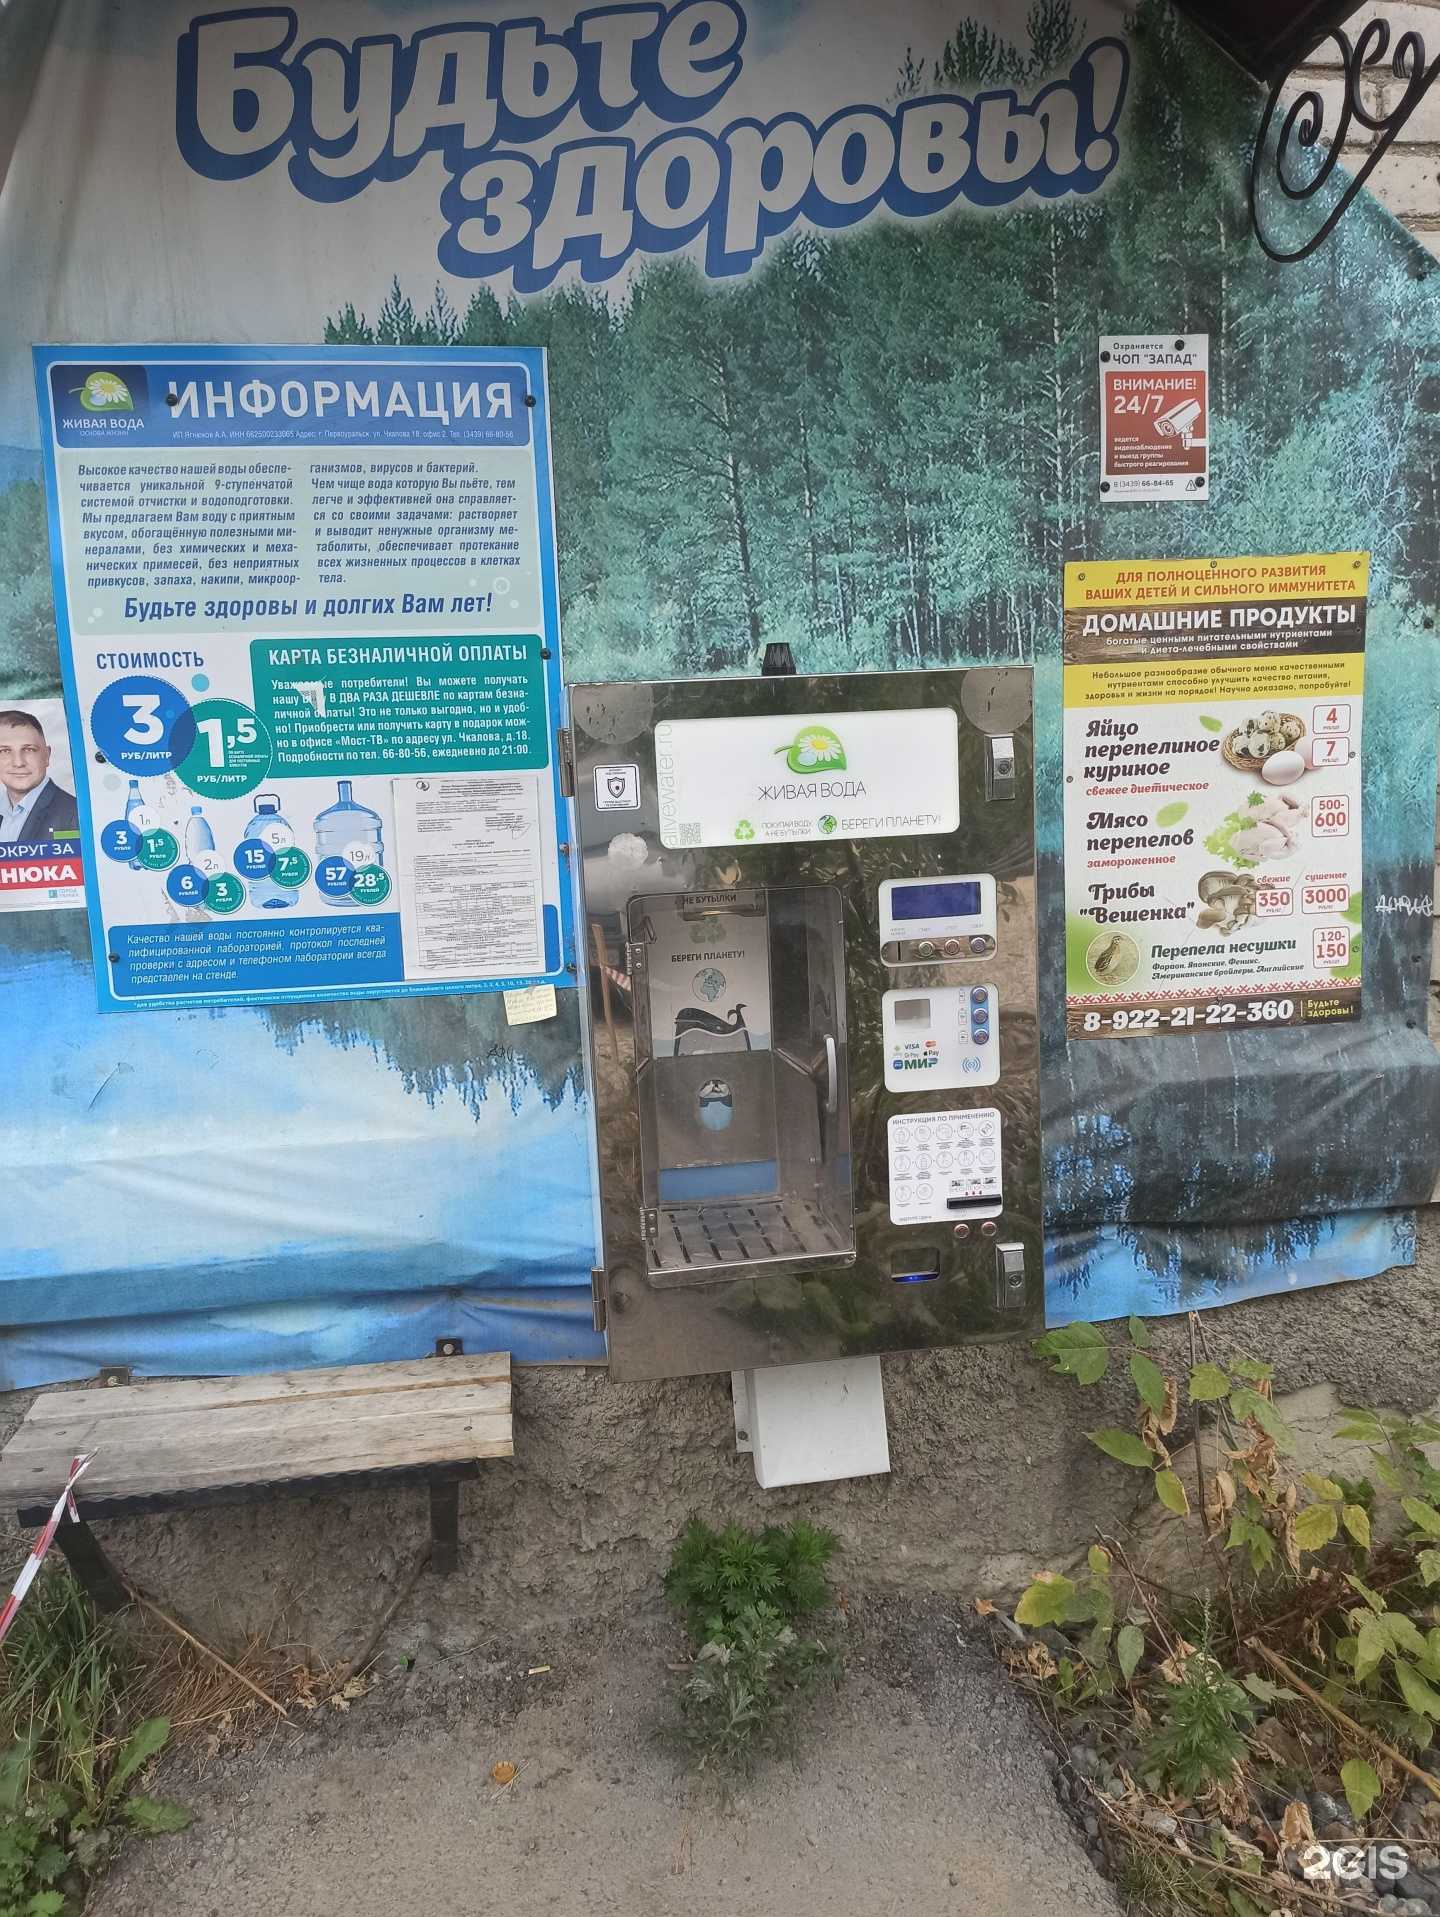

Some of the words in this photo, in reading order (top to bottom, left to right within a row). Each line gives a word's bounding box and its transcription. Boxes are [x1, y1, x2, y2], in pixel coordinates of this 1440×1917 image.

[197, 2, 741, 180] Будьте
[456, 45, 1119, 270] здоровы!
[1113, 354, 1139, 364] ЧОП
[1144, 354, 1197, 365] "ЗАПАД"
[1114, 379, 1196, 390] ВНИМАНИЕ!
[168, 379, 512, 425] ИНФОРМАЦИЯ
[1114, 393, 1164, 414] 24/7
[63, 419, 106, 429] ЖИВАЯ
[111, 419, 144, 429] ВОДА
[78, 465, 127, 475] Высокое
[129, 465, 178, 474] качество
[180, 464, 216, 474] нашей
[218, 465, 246, 475] воды
[371, 465, 413, 474] вирусов
[427, 462, 478, 474] бактерий.
[80, 482, 130, 492] чивается
[141, 480, 205, 492] уникальной
[215, 479, 293, 491] 9-ступенчатой
[338, 480, 365, 490] чище
[368, 480, 393, 489] вода
[396, 480, 439, 490] которую
[81, 497, 135, 508] системой
[139, 497, 187, 507] отчистки
[312, 496, 343, 505] легче
[357, 494, 432, 506] эффективней
[105, 513, 173, 524] предлагаем
[202, 513, 227, 523] воду
[240, 512, 295, 523] приятным
[350, 512, 390, 520] своими
[397, 511, 452, 521] задачами:
[459, 510, 517, 521] растворяет
[210, 528, 274, 538] полезными
[327, 527, 372, 537] выводит
[378, 527, 432, 536] ненужные
[438, 526, 494, 536] организму
[180, 544, 245, 554] химических
[379, 542, 453, 551] обеспечивает
[460, 542, 519, 551] протекание
[87, 562, 137, 570] нических
[234, 560, 299, 570] неприятных
[318, 558, 341, 567] всех
[346, 558, 407, 567] жизненных
[411, 557, 466, 568] процессов
[481, 557, 520, 566] клетках
[319, 574, 346, 583] тела.
[1117, 572, 1142, 584] ДЛЯ
[1147, 568, 1257, 582] ПОЛНОЦЕННОГО
[1262, 565, 1326, 577] РАЗВИТИЯ
[1086, 588, 1131, 600] ВАШИХ
[1136, 585, 1177, 599] ДЕТЕЙ
[1182, 585, 1190, 596] И
[1194, 584, 1264, 596] СИЛЬНОГО
[1269, 580, 1355, 592] ИММУНИТЕТА
[124, 598, 196, 622] Будьте
[204, 600, 297, 620] здоровы
[305, 599, 316, 614] и
[323, 597, 395, 617] долгих
[402, 594, 444, 614] Вам
[450, 592, 492, 612] лет!
[1083, 610, 1221, 636] ДОМАШНИЕ
[1230, 604, 1355, 630] ПРОДУКТЫ
[1106, 637, 1146, 646] богатые
[1151, 635, 1194, 645] ценными
[1197, 632, 1267, 643] питательными
[1270, 629, 1333, 640] нутриентами
[269, 649, 321, 665] КАРТА
[327, 643, 453, 664] БЕЗНАЛИЧНОЙ
[459, 645, 527, 661] ОПЛАТЫ
[1150, 642, 1237, 655] диета-лечебными
[1240, 641, 1298, 650] свойствами
[97, 652, 204, 669] СТОИМОСТЬ
[341, 678, 408, 689] потребители!
[439, 677, 476, 686] можете
[485, 676, 528, 685] получать
[273, 695, 299, 706] нашу
[363, 692, 389, 702] РАЗА
[392, 690, 439, 702] ДЕШЕВЛЕ
[458, 690, 493, 700] картам
[395, 707, 428, 716] только
[1325, 709, 1338, 724] 4
[122, 695, 164, 745] 3
[295, 722, 354, 734] Приобрести
[378, 721, 423, 731] получить
[425, 720, 452, 731] карту
[463, 719, 503, 729] подарок
[1087, 720, 1138, 742] Яйцо
[197, 718, 257, 768] 1,5
[300, 737, 332, 750] офисе
[406, 734, 439, 745] адресу
[1085, 738, 1220, 759] перепелиное
[1326, 741, 1336, 756] 7
[121, 752, 172, 760] РУБ/ЛИТР
[278, 751, 344, 764] Подробности
[433, 747, 486, 758] ежедневно
[1084, 762, 1170, 782] куриное
[197, 775, 247, 783] РУБ/ЛИТР
[659, 723, 677, 848] alivewater.ru
[758, 783, 817, 800] ЖИВАЯ
[820, 781, 866, 798] ВОДА
[1086, 786, 1128, 796] свежее
[1130, 781, 1209, 794] диетическое
[1319, 800, 1344, 810] 500-
[842, 817, 884, 831] БЕРЕГИ
[885, 814, 942, 828] ПЛАНЕТУ!
[1086, 811, 1148, 830] Мясо
[1315, 813, 1345, 827] 600
[116, 831, 128, 844] 3
[1087, 829, 1193, 852] перепелов
[52, 843, 74, 855] ЗА
[244, 850, 264, 862] 15
[1088, 855, 1176, 868] замороженное
[326, 868, 346, 880] 57
[1257, 875, 1290, 884] свежие
[1305, 872, 1347, 881] сушеные
[181, 876, 193, 889] 6
[216, 883, 228, 896] 3
[1088, 883, 1155, 904] Грибы
[1305, 889, 1346, 903] 3000
[695, 895, 736, 904] БУТЫЛКИ
[1258, 891, 1290, 906] 350
[1079, 902, 1194, 923] "Вешенка"
[1320, 931, 1344, 941] 120-
[1152, 945, 1225, 961] Перепела
[1229, 938, 1296, 955] несушки
[1317, 944, 1346, 958] 150
[672, 953, 702, 963] БЕРЕГИ
[704, 951, 745, 961] ПЛАНЕТУ!
[1084, 1000, 1294, 1032] 8-922-21-22-360
[1308, 1000, 1339, 1008] Будьте
[1308, 1006, 1354, 1017] здоровы!
[905, 1058, 938, 1069] МИР
[892, 1116, 936, 1124] ИНСТРУКЦИЯ
[949, 1112, 994, 1121] ПРИМЕНЕНИЮ
